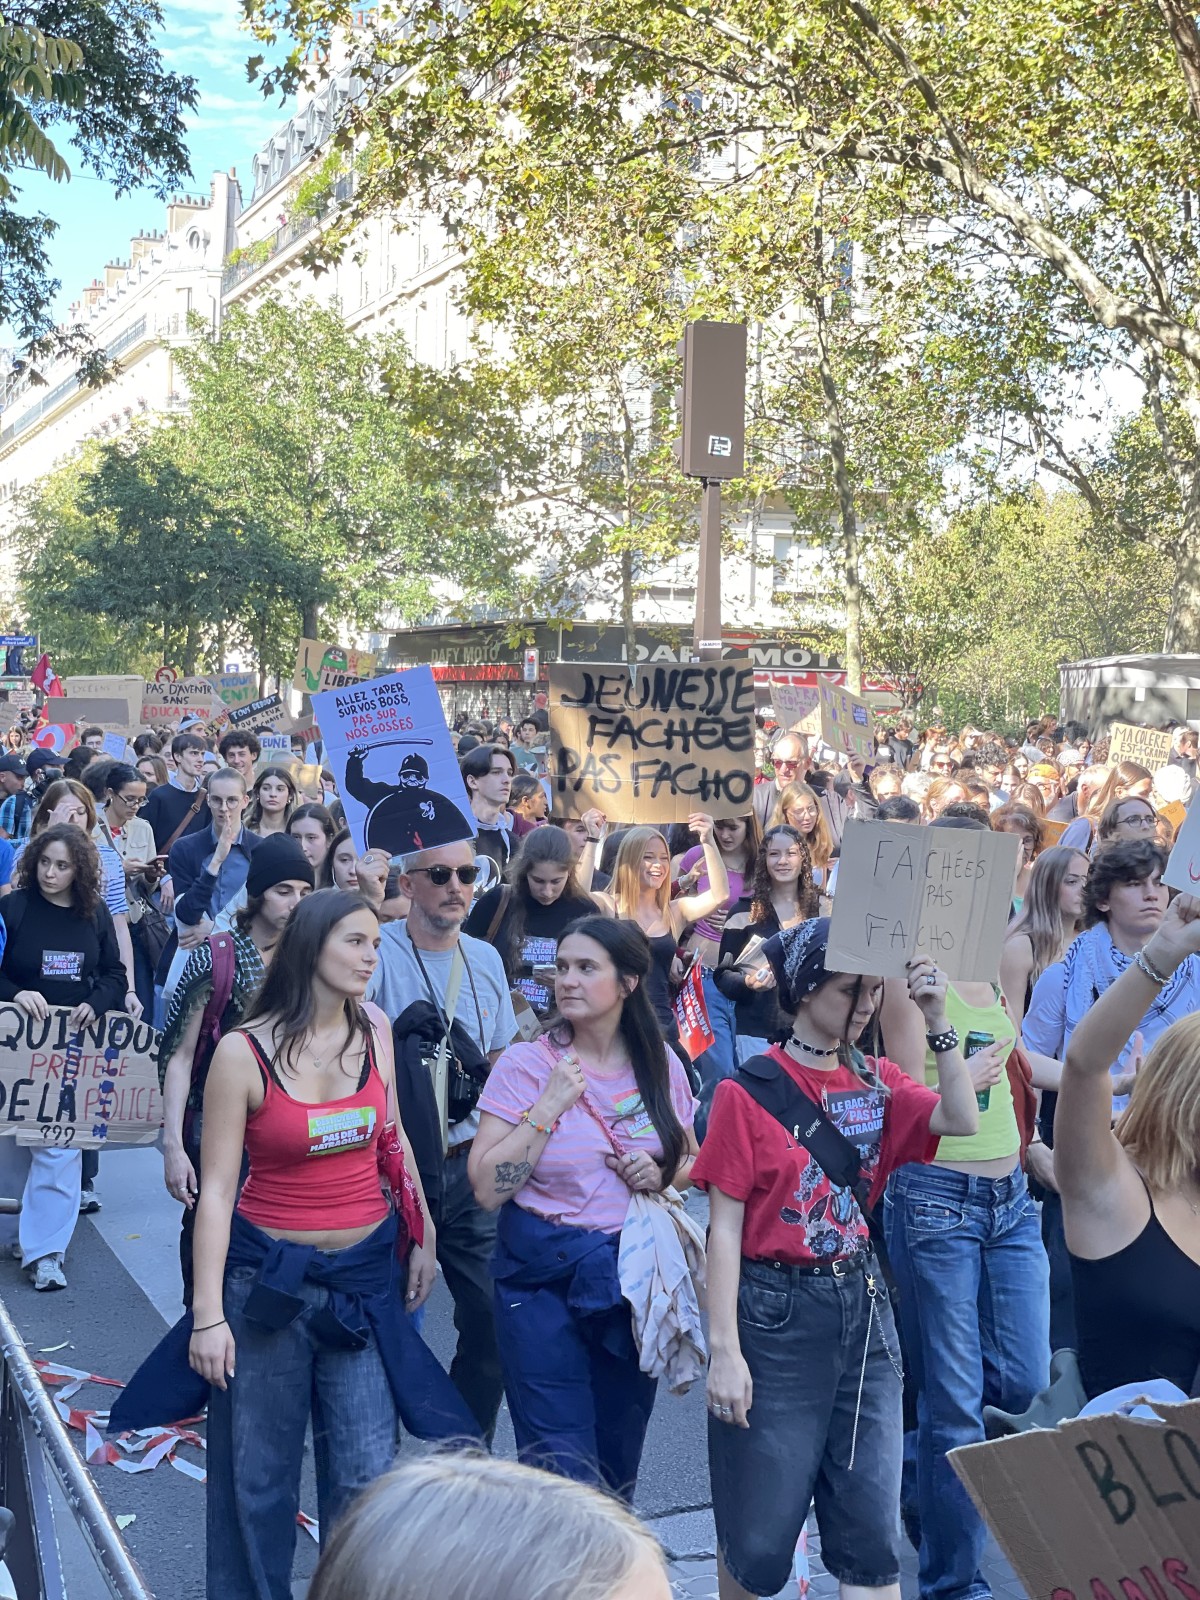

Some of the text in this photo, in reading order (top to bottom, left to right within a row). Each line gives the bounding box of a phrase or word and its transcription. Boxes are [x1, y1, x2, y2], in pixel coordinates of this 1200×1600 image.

[431, 645, 499, 664] DAFY MOTO
[621, 643, 735, 664] DAF
[146, 683, 212, 696] PAS D'AVENIR
[162, 695, 190, 704] SANS
[335, 682, 405, 709] ALLEZ TAPER
[561, 665, 754, 716] JEUNESSE
[231, 705, 251, 720] TOUS
[338, 693, 411, 719] SUR VOS BOSS,
[235, 705, 281, 730] POUR CEUX
[260, 712, 285, 726] CHAISE
[352, 707, 397, 728] PAS SUR
[345, 716, 414, 742] NOS GOSSES
[1114, 726, 1133, 743] MA
[1120, 742, 1137, 754] EST
[1144, 746, 1169, 759] GRANDE
[557, 746, 753, 804] PAS FACHO
[873, 840, 986, 882] FACHÉES
[926, 883, 953, 908] PAS
[865, 912, 955, 951] FACHO
[54, 961, 67, 969] PAS
[521, 985, 546, 996] PAS LES
[686, 1006, 698, 1029] PAS
[0, 1006, 72, 1051] QUI
[680, 1020, 693, 1038] LE
[36, 1081, 78, 1123] LA
[84, 1087, 158, 1121] POLICE
[831, 1101, 844, 1114] LE
[849, 1108, 870, 1122] PAS
[40, 1124, 76, 1149] ???
[312, 1125, 334, 1136] POUR
[322, 1128, 358, 1143] PAS DES
[310, 1134, 365, 1152] MATRAQUES
